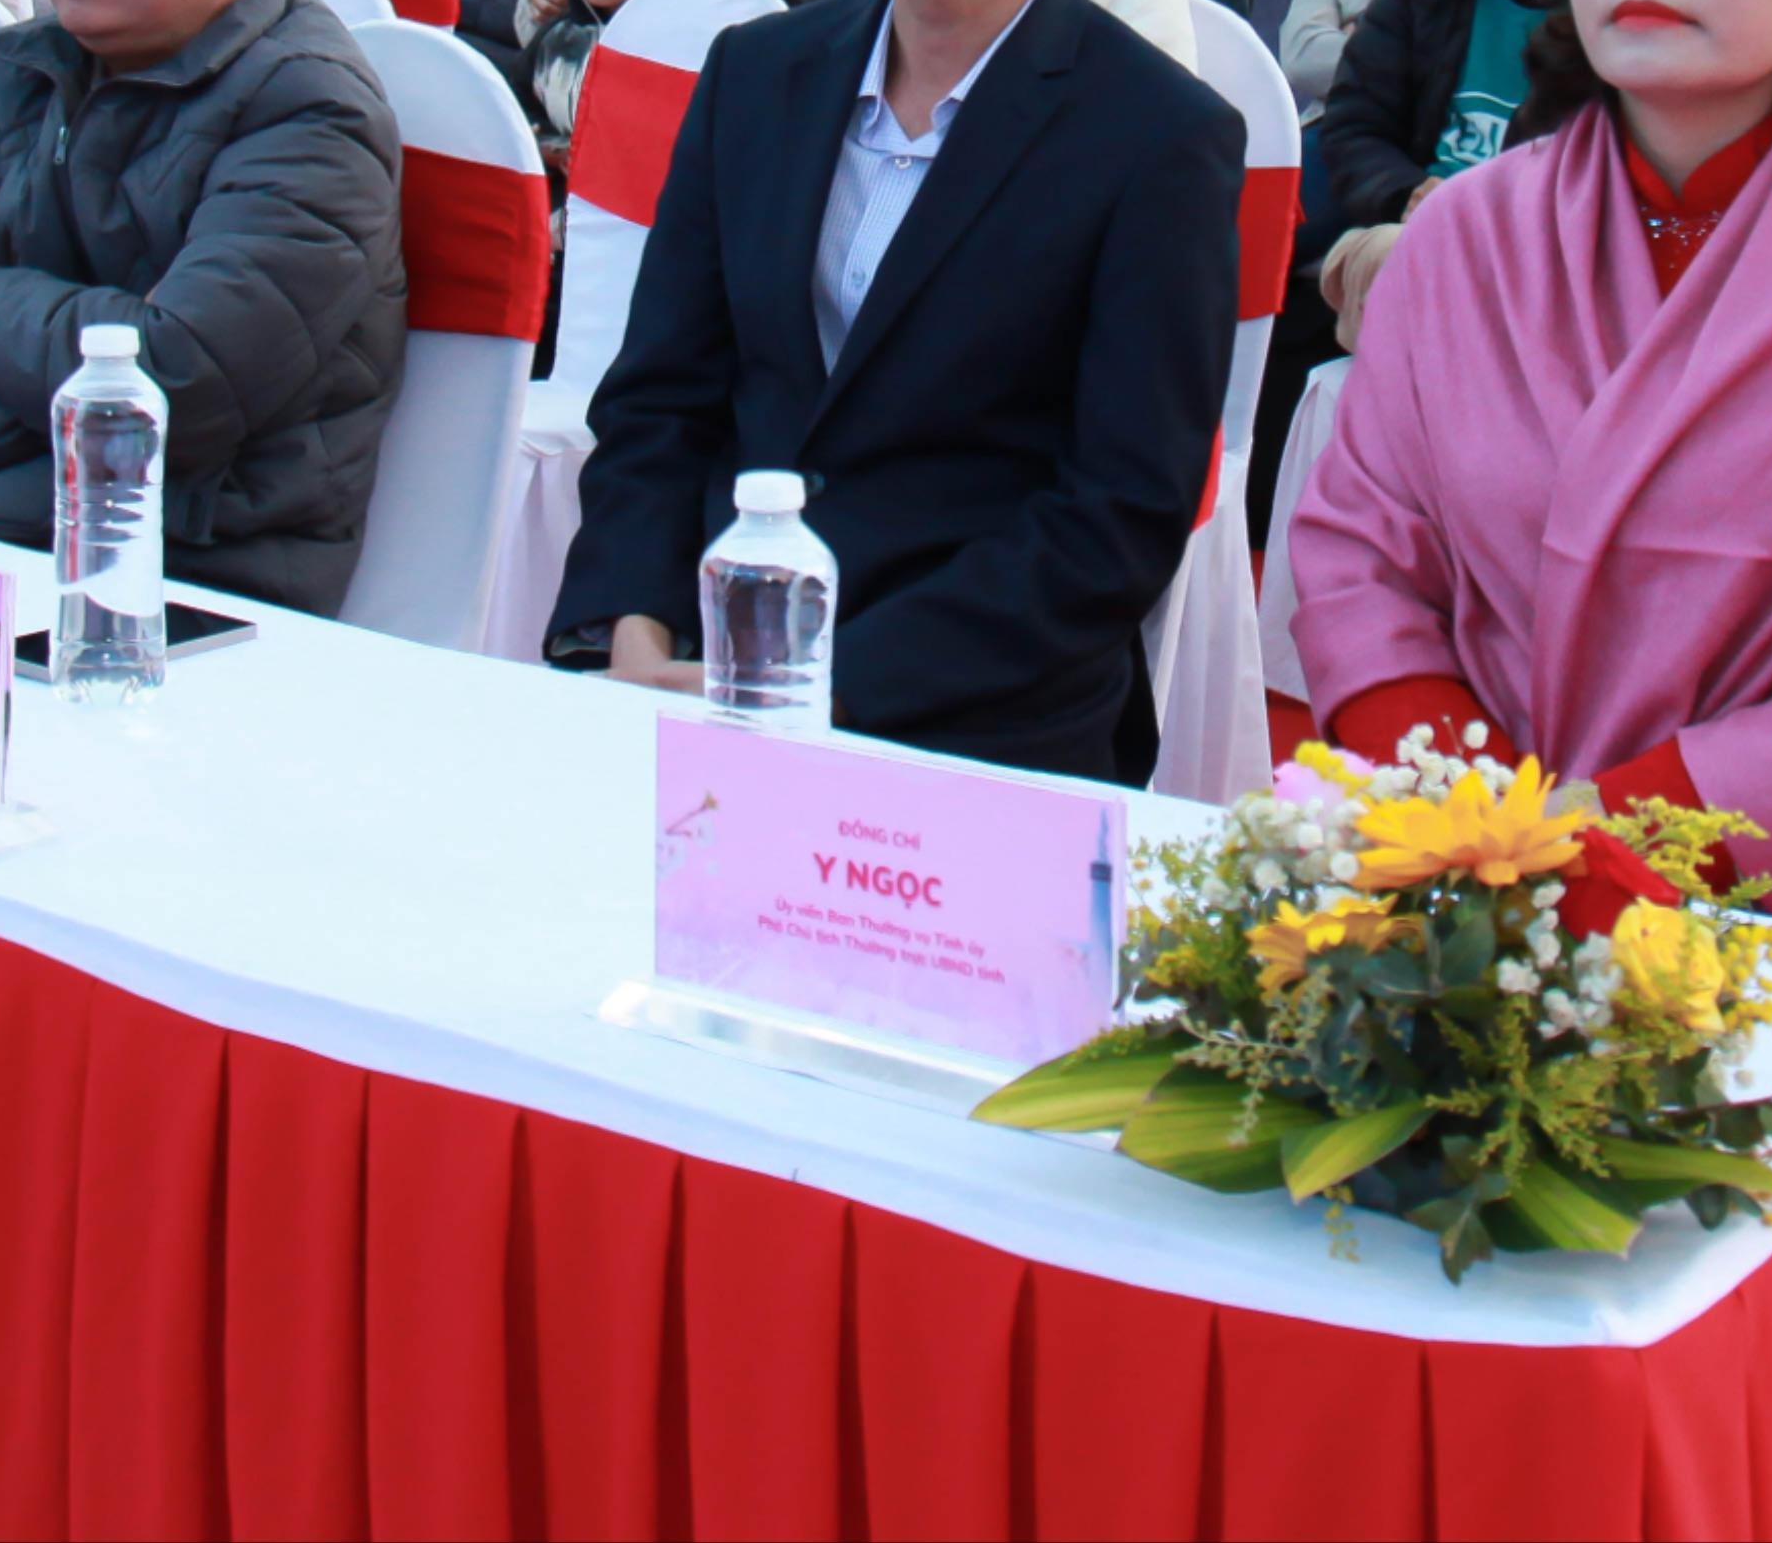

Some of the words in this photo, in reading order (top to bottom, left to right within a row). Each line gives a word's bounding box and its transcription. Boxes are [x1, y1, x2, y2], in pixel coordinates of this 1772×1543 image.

[838, 818, 889, 845] ĐỒNG
[893, 831, 922, 851] CHÍ
[812, 851, 837, 884] Y
[846, 859, 943, 910] NGỌC
